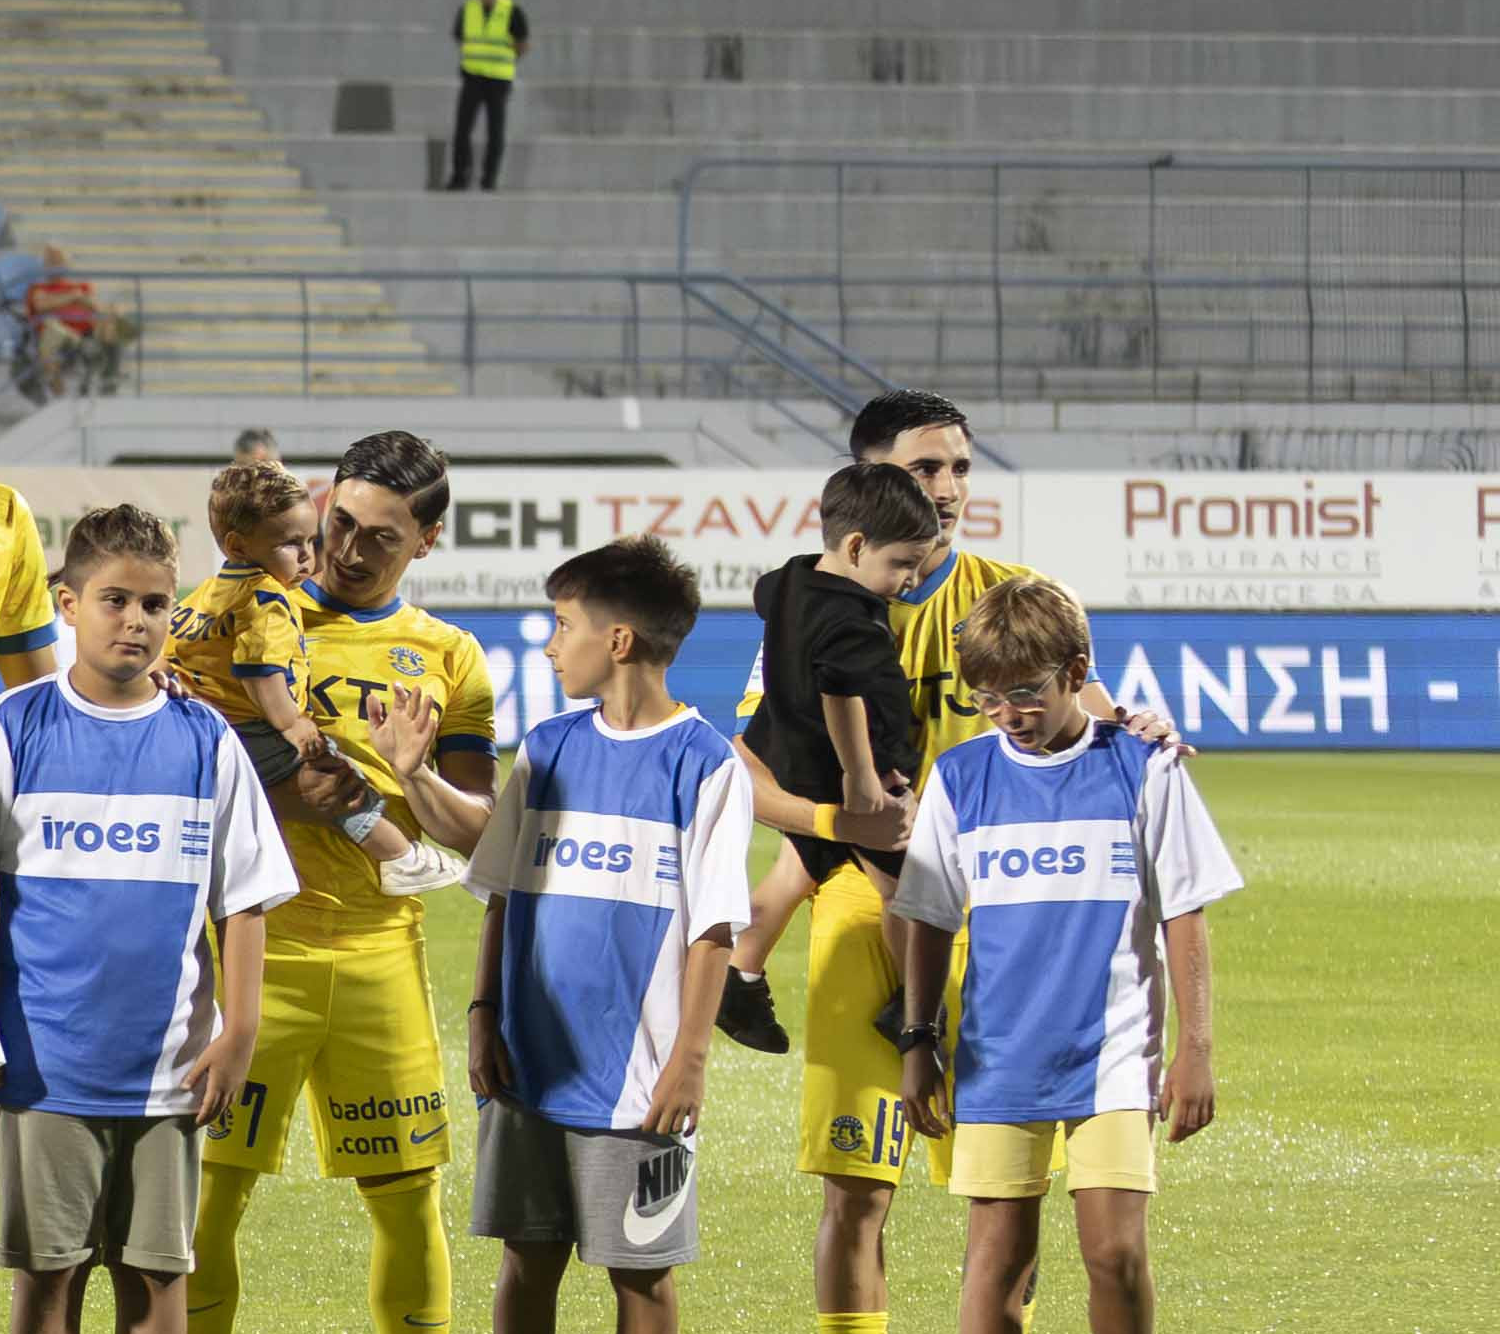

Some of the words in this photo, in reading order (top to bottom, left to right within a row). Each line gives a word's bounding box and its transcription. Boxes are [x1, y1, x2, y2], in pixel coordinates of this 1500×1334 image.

[1125, 481, 1380, 538] Promist
[1127, 550, 1381, 571] INSURANCE
[1162, 584, 1317, 604] FINANCE
[41, 815, 160, 854] iroes
[533, 832, 633, 873] iroes
[329, 1086, 446, 1123] badounas
[336, 1133, 398, 1155] .com
